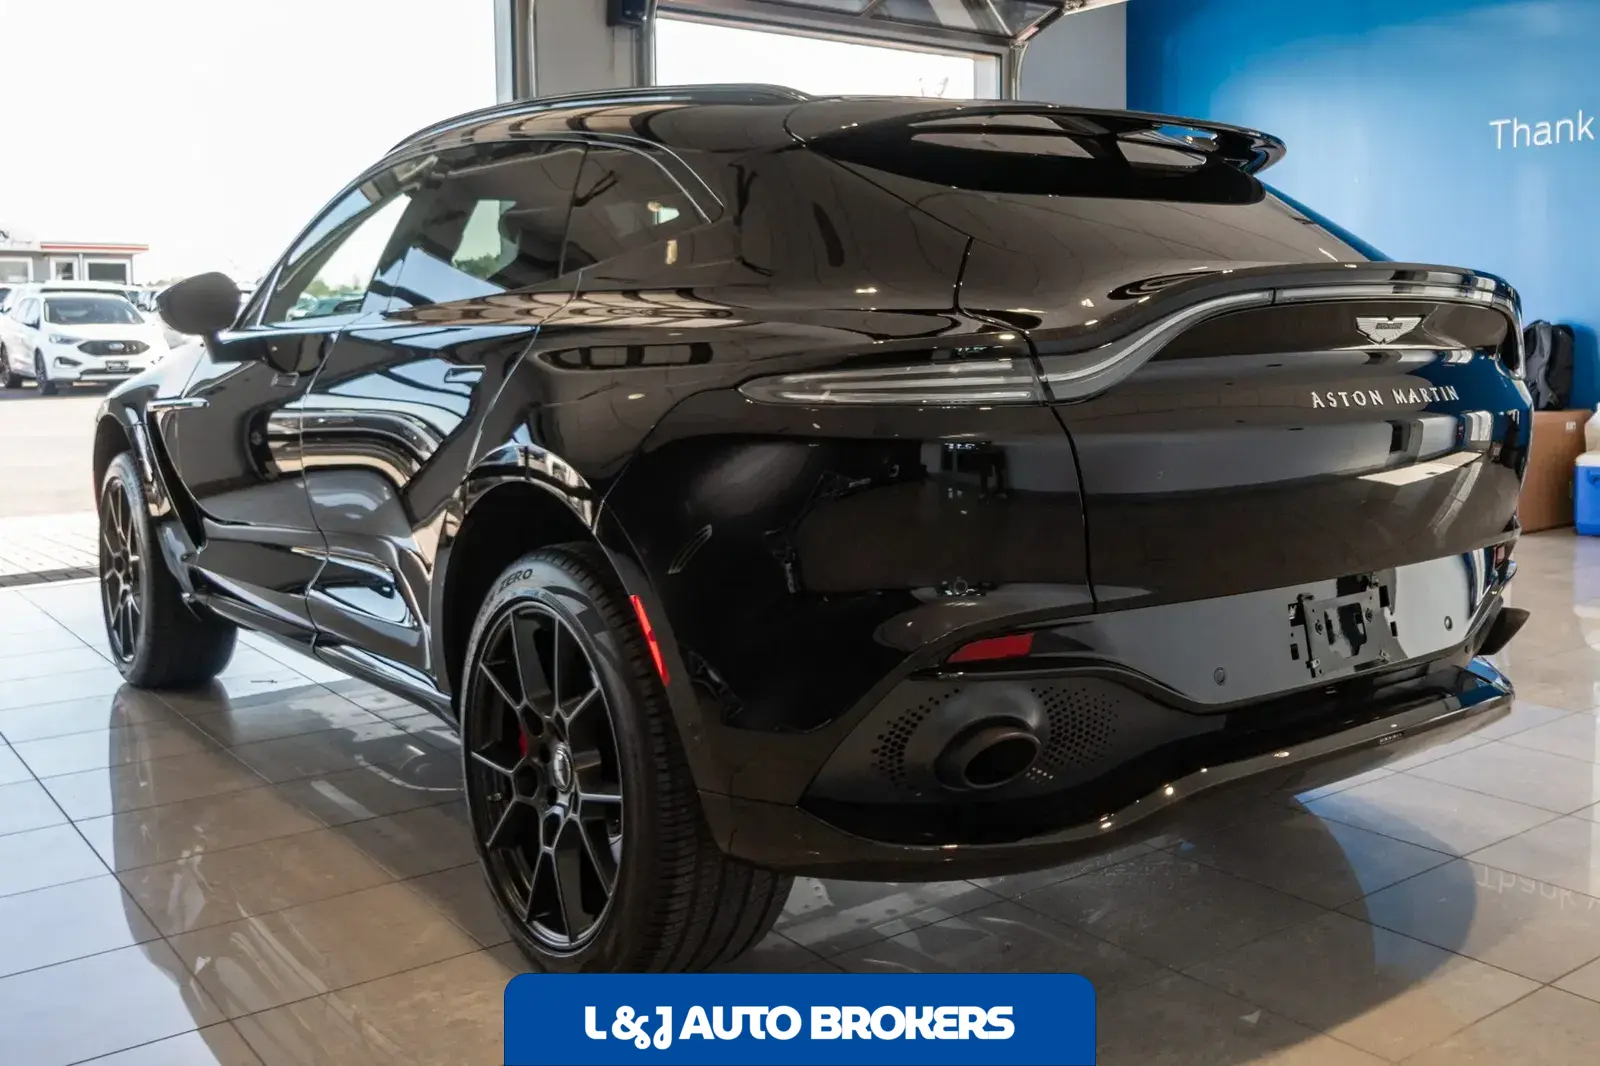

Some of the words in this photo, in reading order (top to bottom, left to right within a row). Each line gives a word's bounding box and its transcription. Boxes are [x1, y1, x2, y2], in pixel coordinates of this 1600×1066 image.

[1489, 109, 1595, 149] Thank
[1310, 389, 1384, 409] ASTON
[1392, 385, 1460, 405] MARTIN
[499, 568, 533, 591] ZERO
